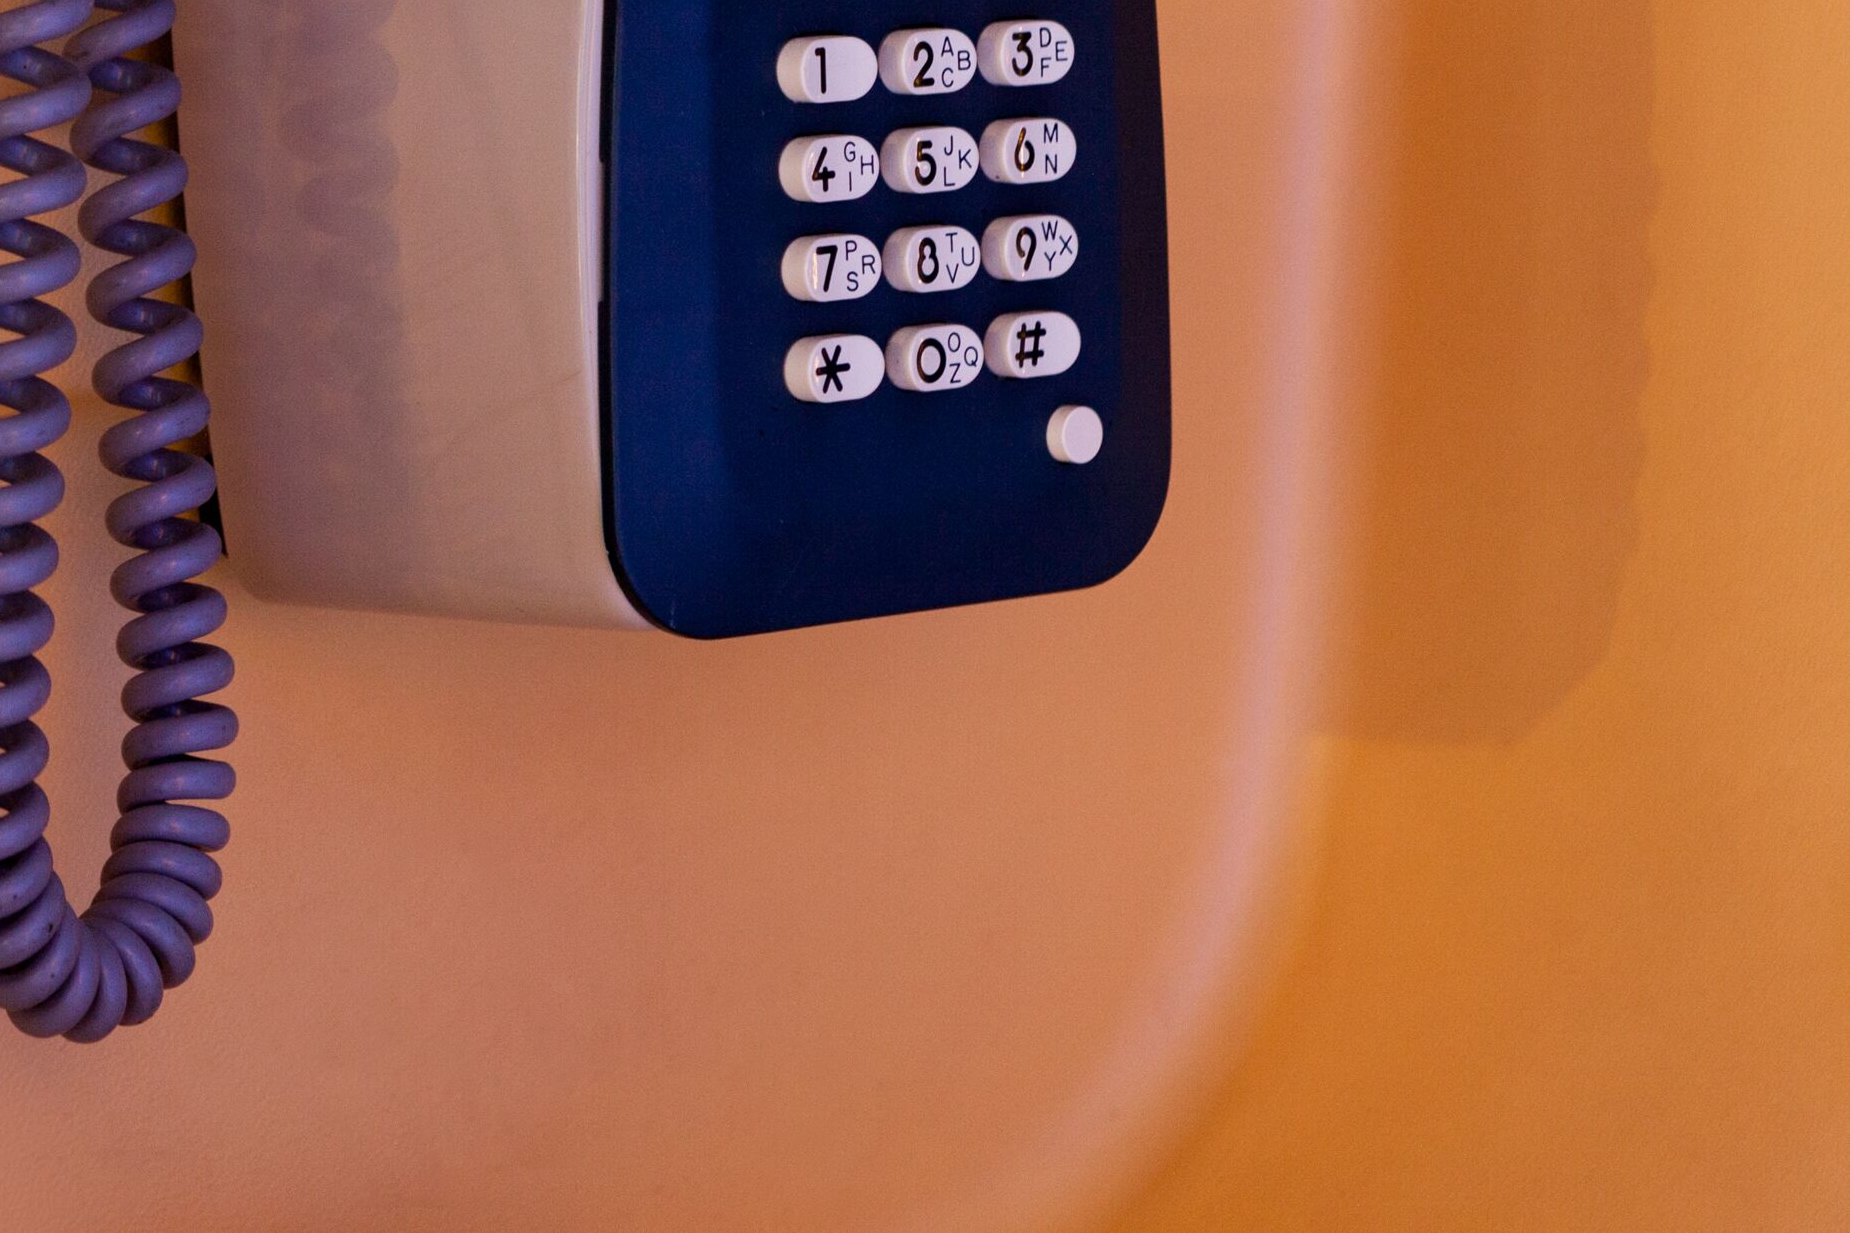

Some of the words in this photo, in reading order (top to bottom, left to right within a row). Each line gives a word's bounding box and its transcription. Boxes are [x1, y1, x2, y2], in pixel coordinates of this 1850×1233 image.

[814, 46, 827, 94] 1
[912, 40, 936, 88] 2
[1011, 31, 1034, 78] 3
[811, 146, 836, 193] 4
[914, 139, 937, 187] 5
[1013, 126, 1036, 173] 6
[815, 244, 838, 293] 7
[916, 236, 940, 285] 8
[1015, 225, 1038, 271] 9
[915, 337, 947, 385] 0
